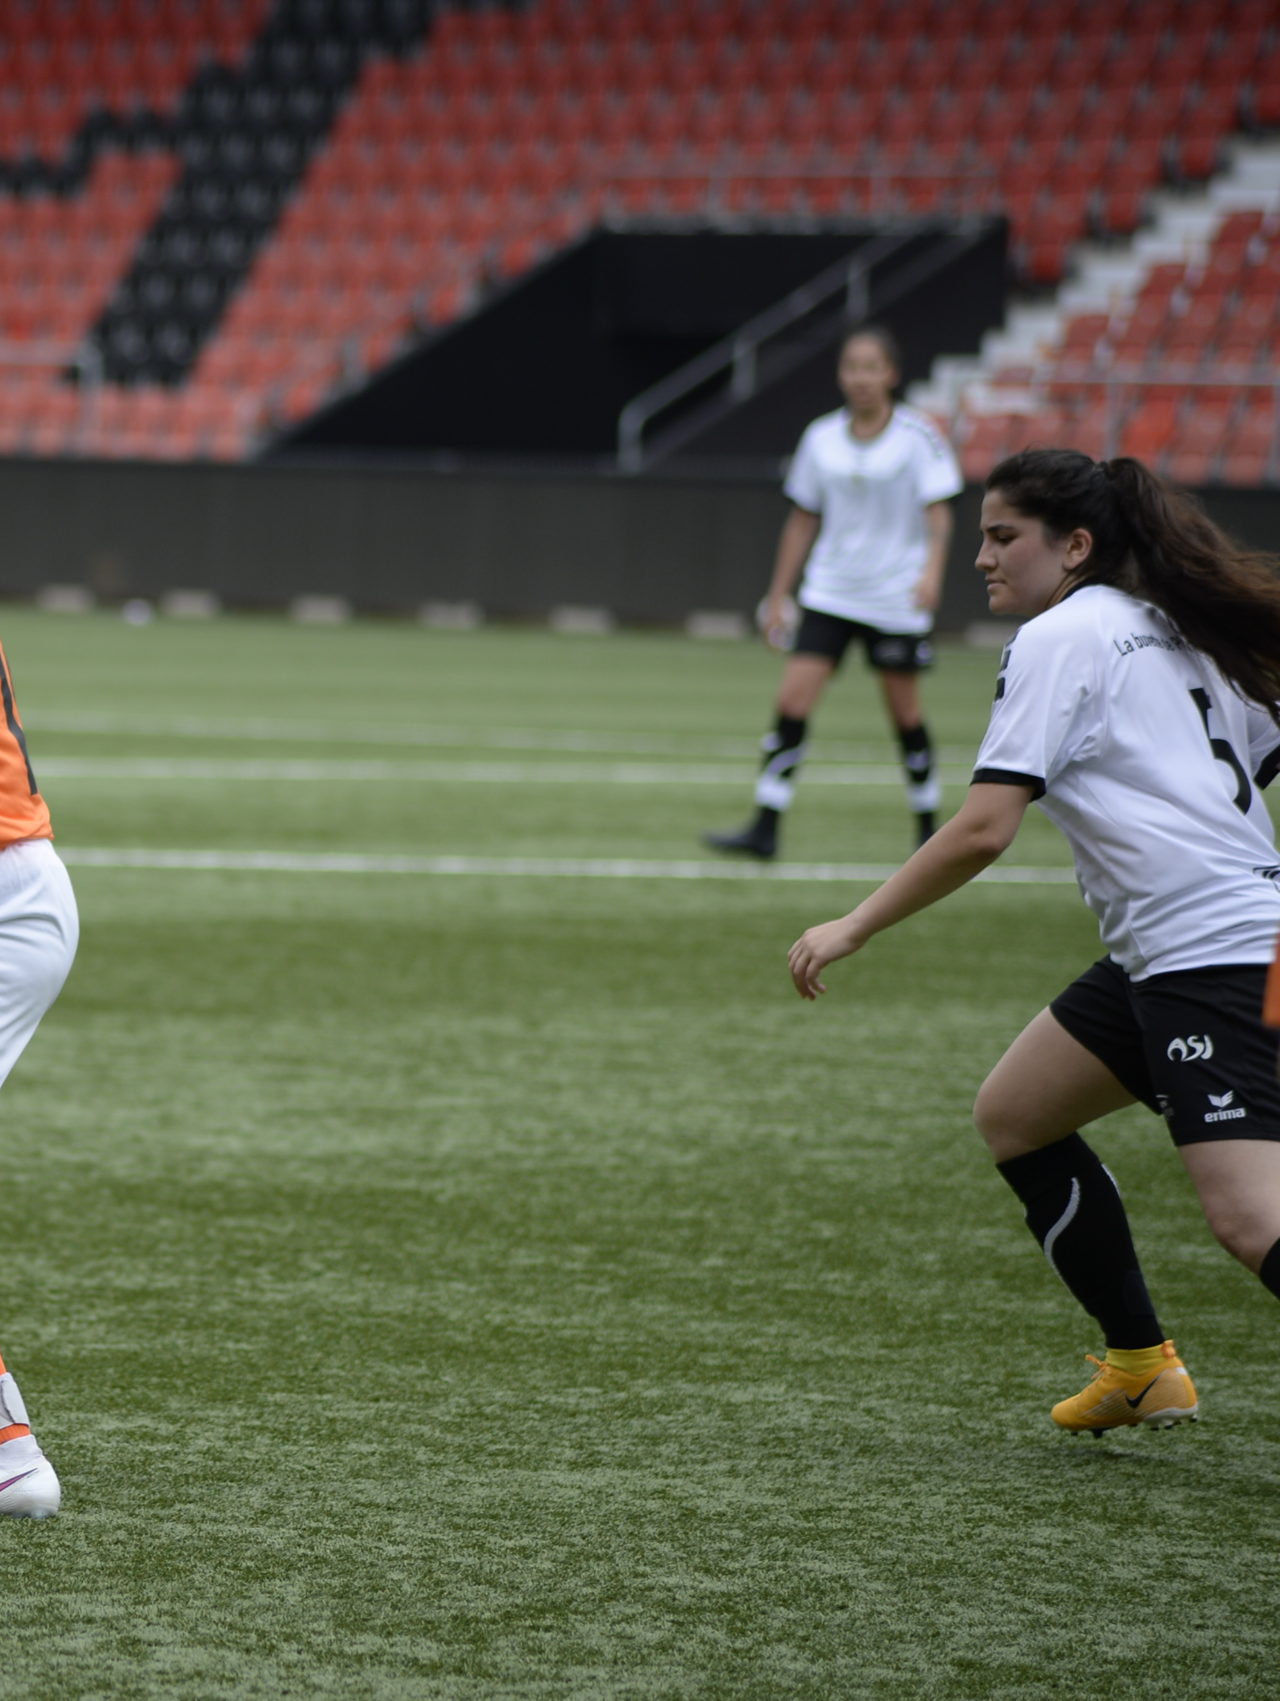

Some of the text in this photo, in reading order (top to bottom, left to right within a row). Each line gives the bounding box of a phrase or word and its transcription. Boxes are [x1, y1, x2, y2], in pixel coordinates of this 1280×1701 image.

[1113, 639, 1135, 656] La
[1189, 688, 1252, 816] 5
[1204, 1107, 1246, 1123] erima
